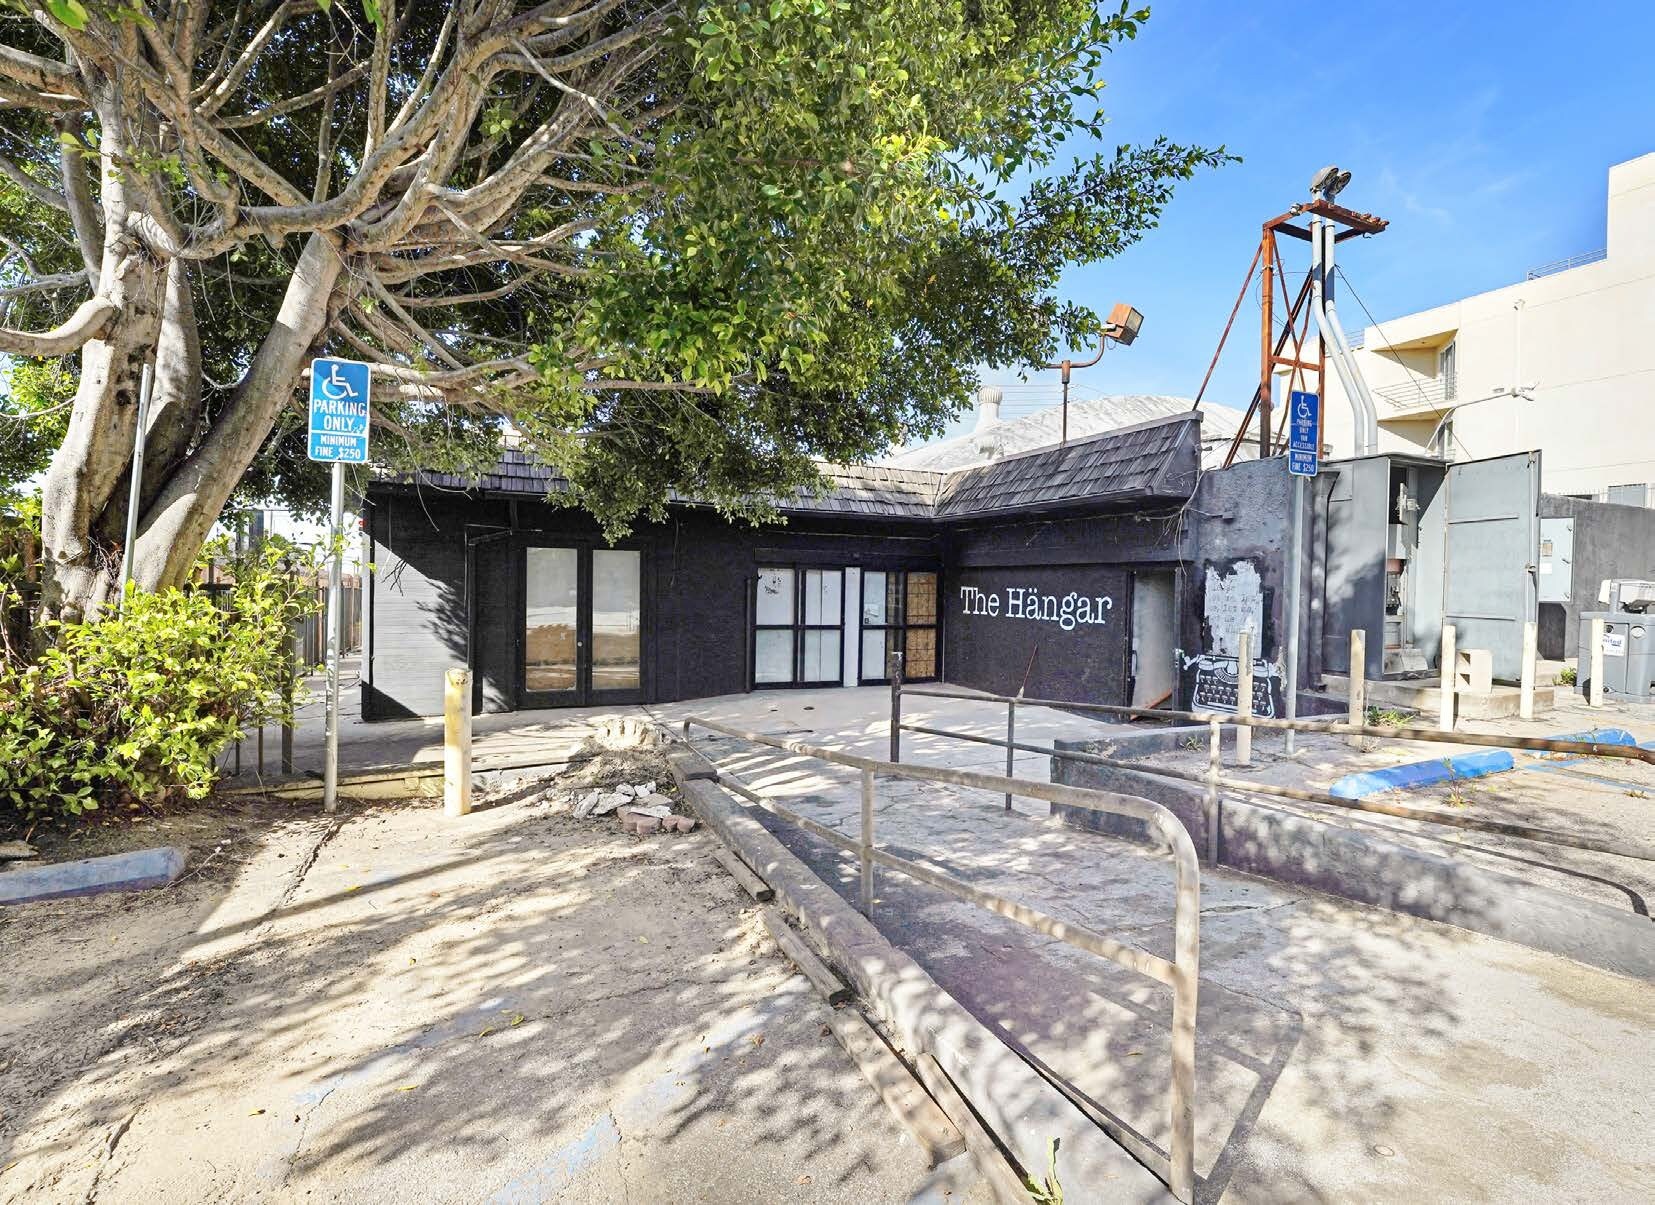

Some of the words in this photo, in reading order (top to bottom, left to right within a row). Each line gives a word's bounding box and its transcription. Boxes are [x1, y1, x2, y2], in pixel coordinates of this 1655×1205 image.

[313, 399, 366, 416] PARKING
[323, 415, 355, 431] ONLY
[320, 435, 357, 447] MINIMUM
[315, 446, 333, 457] FINE
[338, 447, 361, 459] $250
[960, 586, 1000, 617] The
[1005, 587, 1113, 631] Hängar
